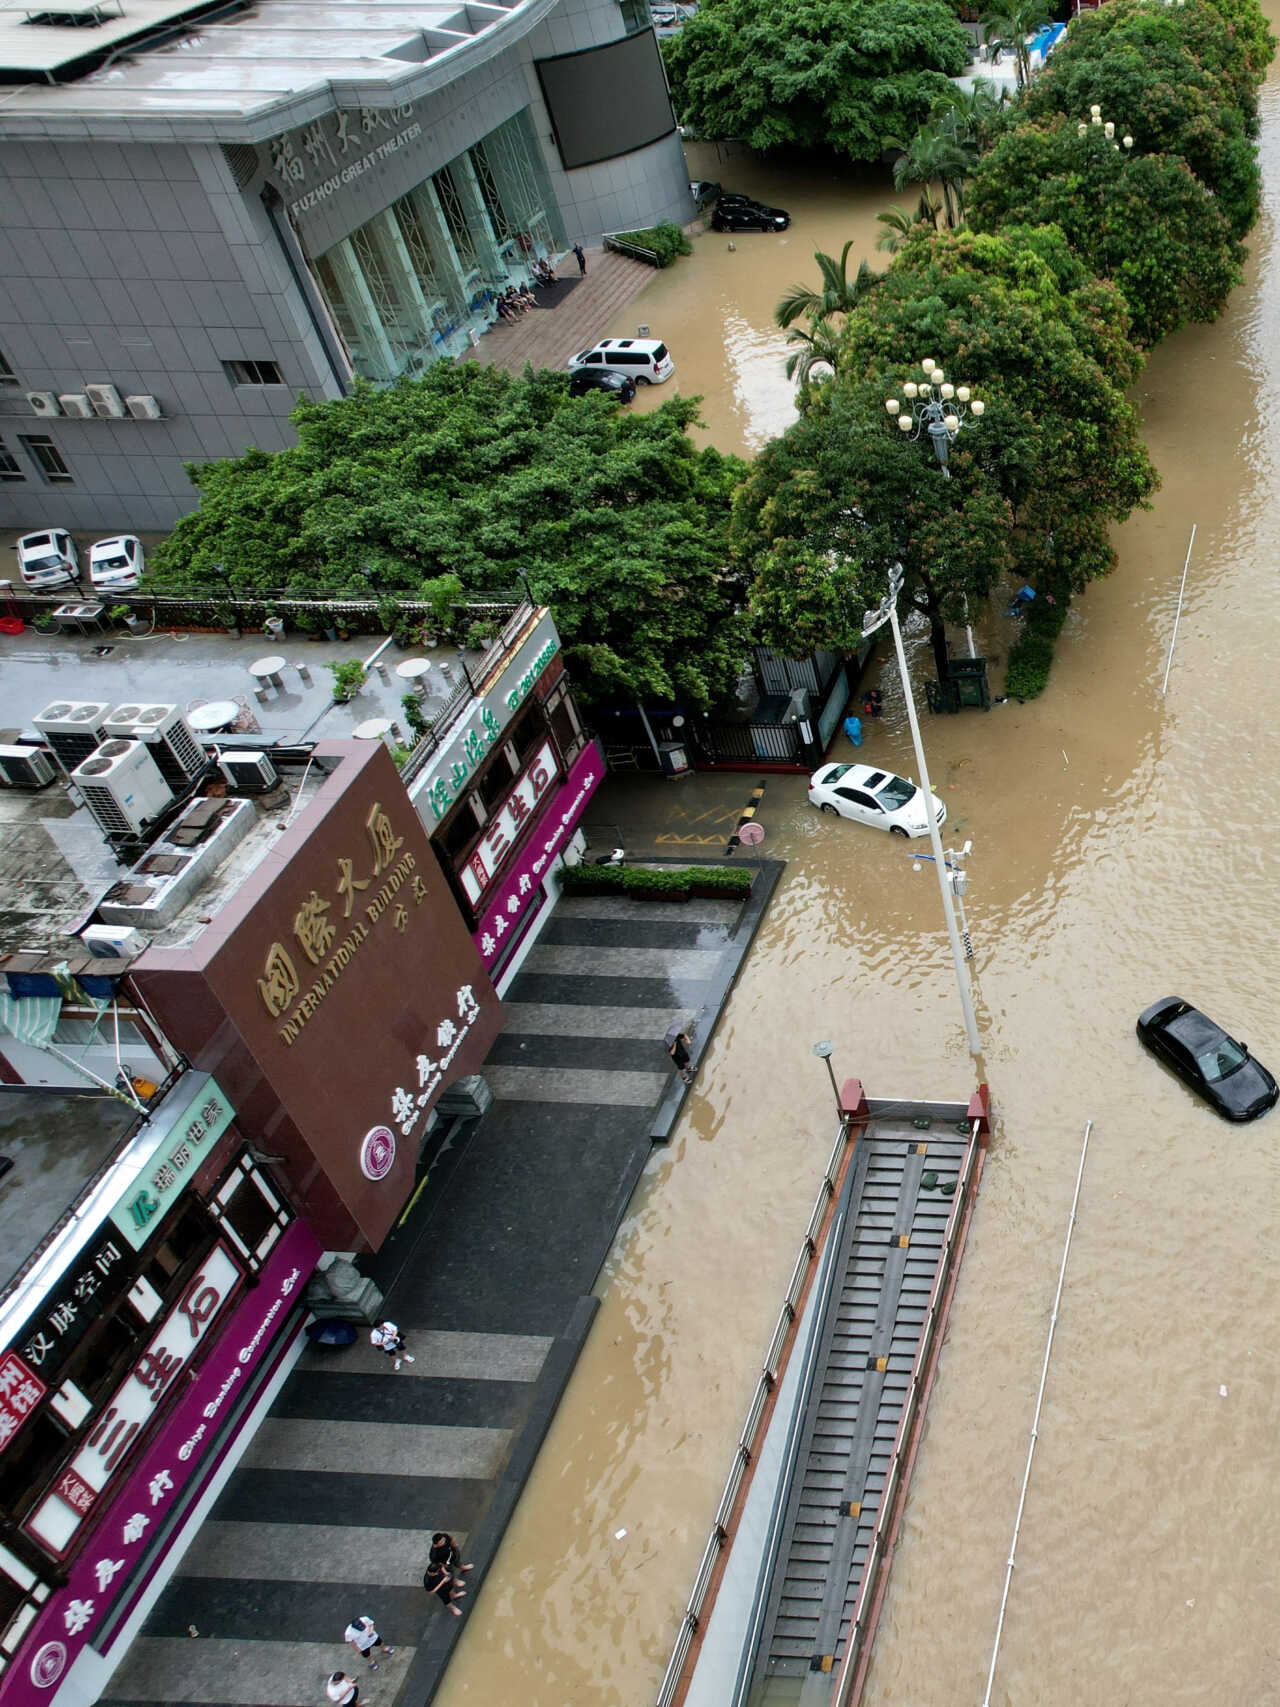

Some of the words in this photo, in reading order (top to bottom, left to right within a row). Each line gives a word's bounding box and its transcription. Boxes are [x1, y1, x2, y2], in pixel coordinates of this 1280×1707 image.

[291, 175, 341, 217] FUZHOU
[341, 152, 377, 184] GREAT
[376, 122, 423, 161] THEATER
[486, 758, 548, 866] 三生石
[279, 922, 369, 1045] INTERNATIONAL
[365, 852, 417, 923] BUILDING
[152, 1099, 225, 1194] 瑞丽世家
[25, 1241, 122, 1366] 汉脉空间
[203, 1366, 242, 1419] Banking
[238, 1298, 283, 1364] Corporation
[87, 1274, 220, 1472] 三生石
